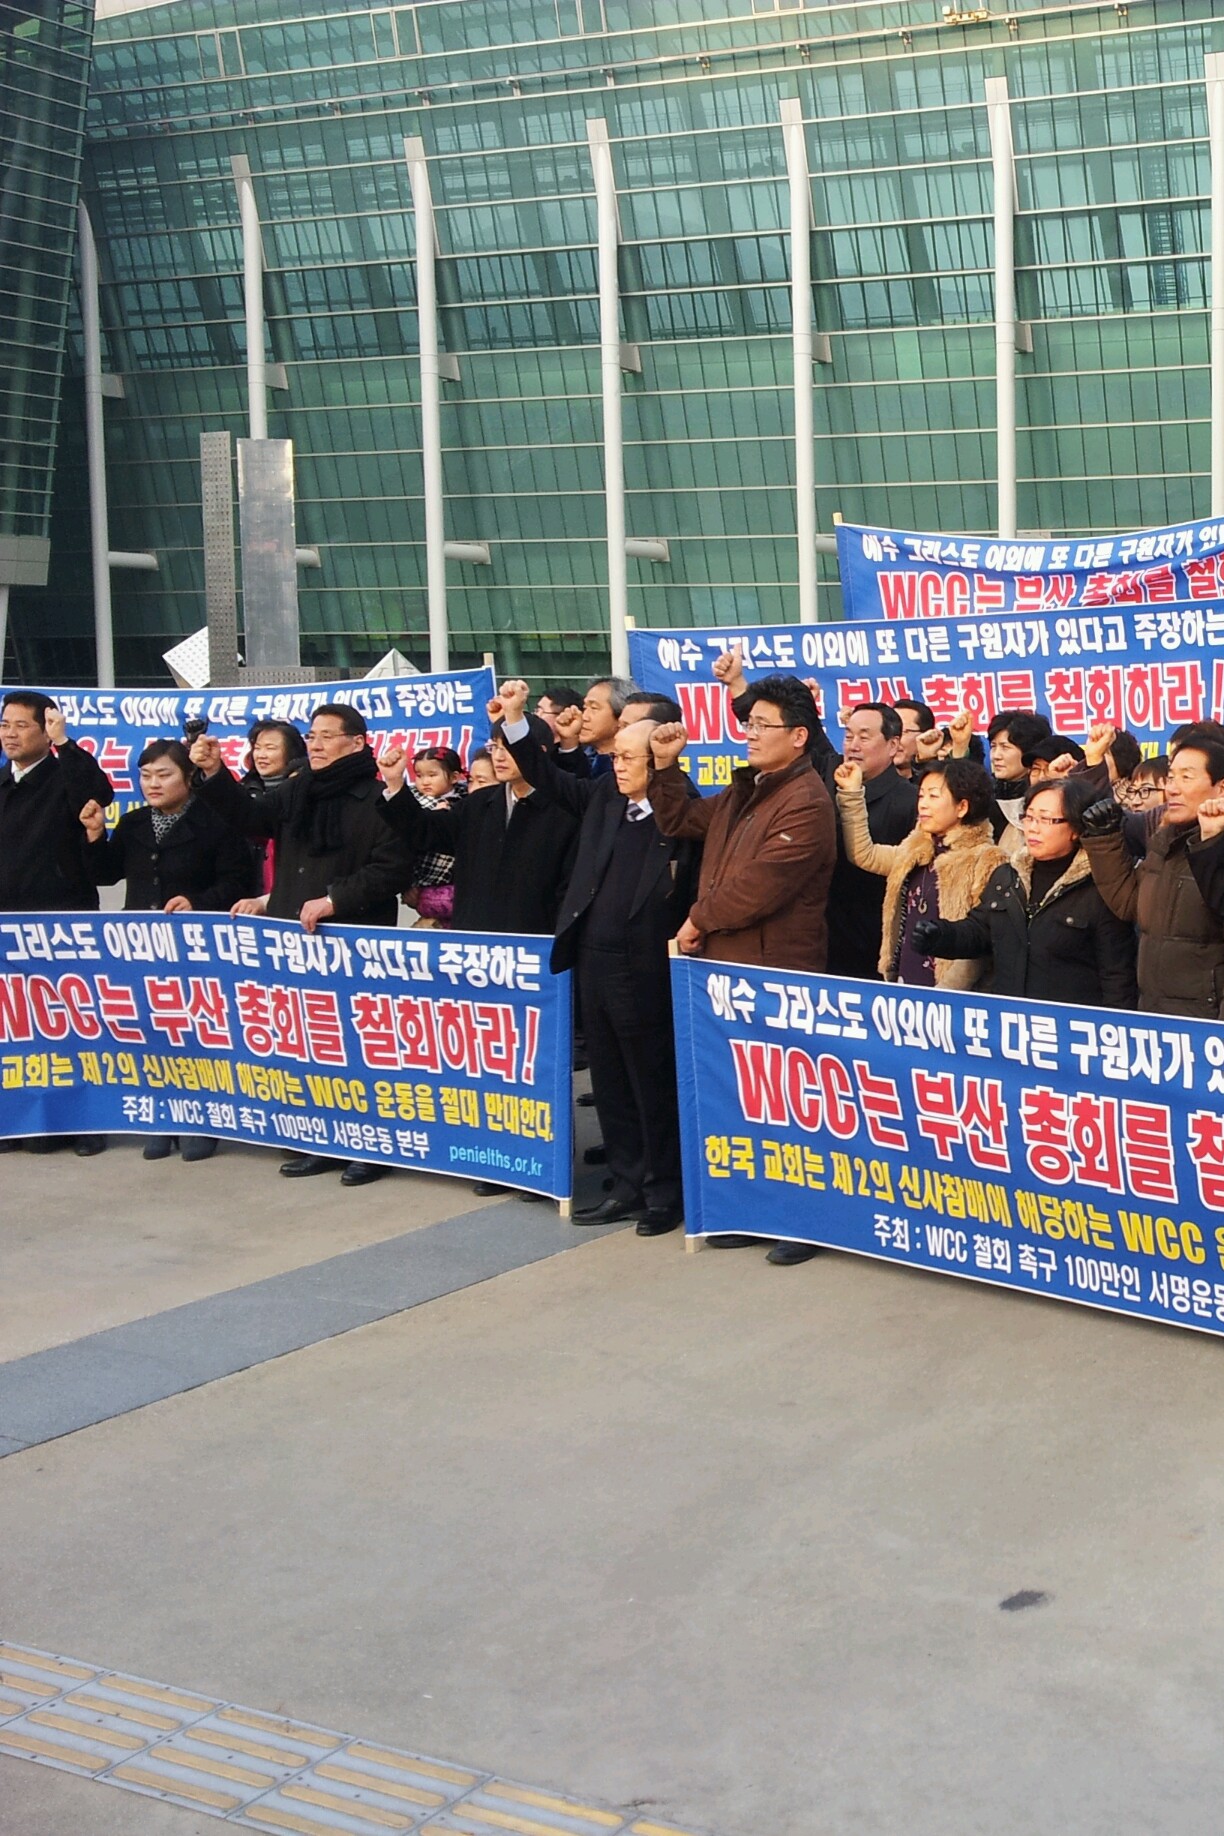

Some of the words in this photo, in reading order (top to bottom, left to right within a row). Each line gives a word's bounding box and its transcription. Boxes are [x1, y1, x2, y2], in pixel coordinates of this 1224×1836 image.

[862, 533, 900, 561] 예수
[903, 537, 980, 569] 그리스도
[984, 543, 1045, 572] 이외에
[1050, 544, 1070, 569] 또
[1073, 542, 1114, 569] 다른
[1117, 529, 1194, 565] 구원자가
[876, 571, 1005, 620] WCC는
[657, 637, 704, 672] 예수
[802, 629, 870, 668] 이외에
[875, 629, 901, 664] 또
[903, 625, 951, 664] 다른
[958, 617, 1051, 661] 구원자가
[1056, 614, 1128, 657] 있다고
[52, 695, 118, 726] 리스도
[120, 695, 179, 727] 이외에
[207, 695, 249, 726] 다른
[395, 680, 475, 717] 주장하는
[1, 922, 101, 961] 그리스도
[102, 920, 179, 962] 이외에
[182, 922, 211, 962] 또
[212, 922, 260, 967] 다른
[262, 928, 354, 977] 구원자가
[355, 937, 434, 982] 있다고
[437, 942, 541, 992] 주장하는
[143, 975, 235, 1050] 부산
[234, 978, 348, 1067] 총회를
[706, 972, 757, 1025] 예수
[762, 980, 869, 1041] 그리스도
[871, 994, 956, 1055] 이외에
[963, 1005, 993, 1059] 또
[999, 1011, 1059, 1072] 다른
[1069, 1019, 1195, 1089] 구원자가
[1, 1052, 74, 1090] 교회는
[141, 1053, 236, 1096] 신사참배에
[235, 1061, 305, 1107] 해당하는
[304, 1073, 369, 1114] WCC
[374, 1080, 437, 1122] 운동을
[438, 1086, 480, 1129] 절대
[483, 1091, 555, 1143] 반대한다.
[122, 1095, 154, 1124] 주최
[168, 1098, 205, 1126] WCC
[205, 1101, 238, 1131] 철회
[238, 1106, 268, 1137] 촉구
[269, 1111, 329, 1145] 100만인
[332, 1120, 394, 1155] 서명운동
[394, 1128, 431, 1160] 본부
[728, 1037, 910, 1152] WCC는
[911, 1067, 1012, 1174] 부산
[1018, 1084, 1180, 1205] 총회를
[449, 1143, 543, 1177] penielths.or.kr
[704, 1134, 756, 1180] 한국
[760, 1143, 826, 1192] 교회는
[898, 1168, 1013, 1229] 신사참배에
[1014, 1188, 1116, 1251] 해당하는
[1117, 1209, 1206, 1266] WCC
[873, 1213, 911, 1252] 주최
[925, 1224, 968, 1264] WCC
[972, 1232, 1012, 1273] 철회
[1017, 1242, 1058, 1284] 촉구
[1064, 1253, 1142, 1304] 100만인
